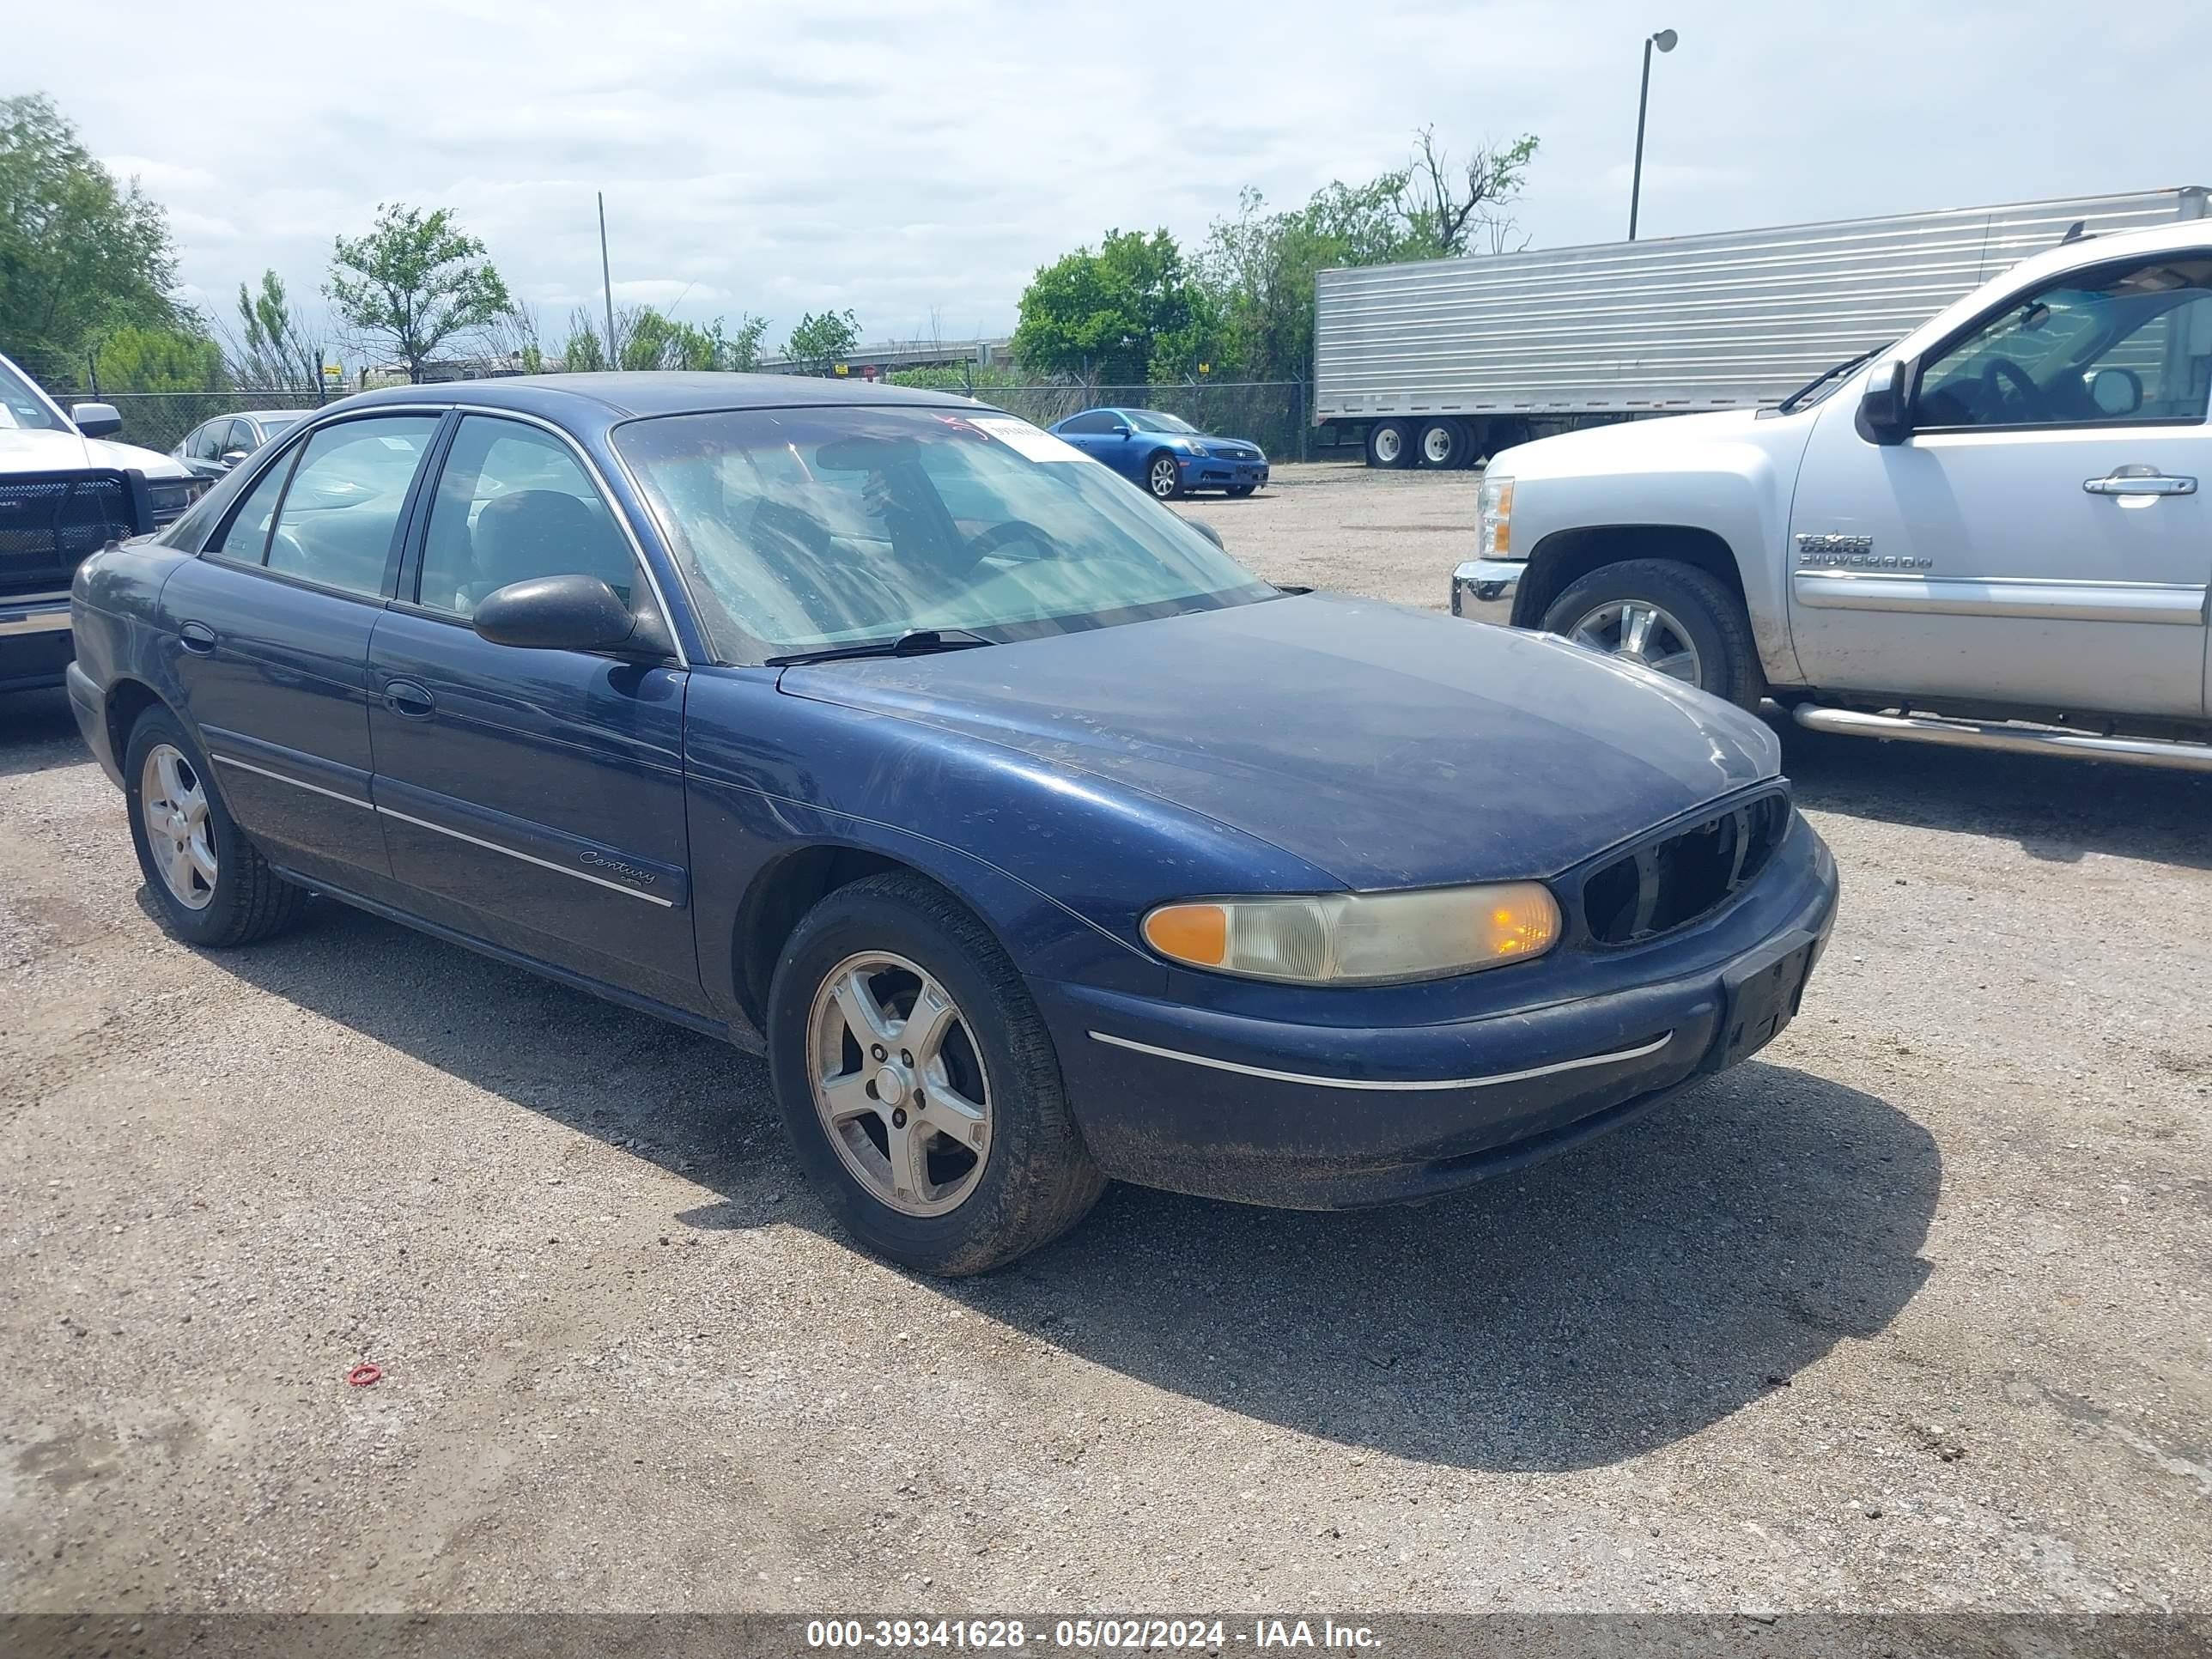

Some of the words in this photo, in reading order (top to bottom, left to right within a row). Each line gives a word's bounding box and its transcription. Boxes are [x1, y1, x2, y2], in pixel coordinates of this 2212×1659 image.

[1795, 531, 1873, 546] TEXAS
[1799, 555, 1933, 568] SILVERADO
[579, 851, 656, 884] Century
